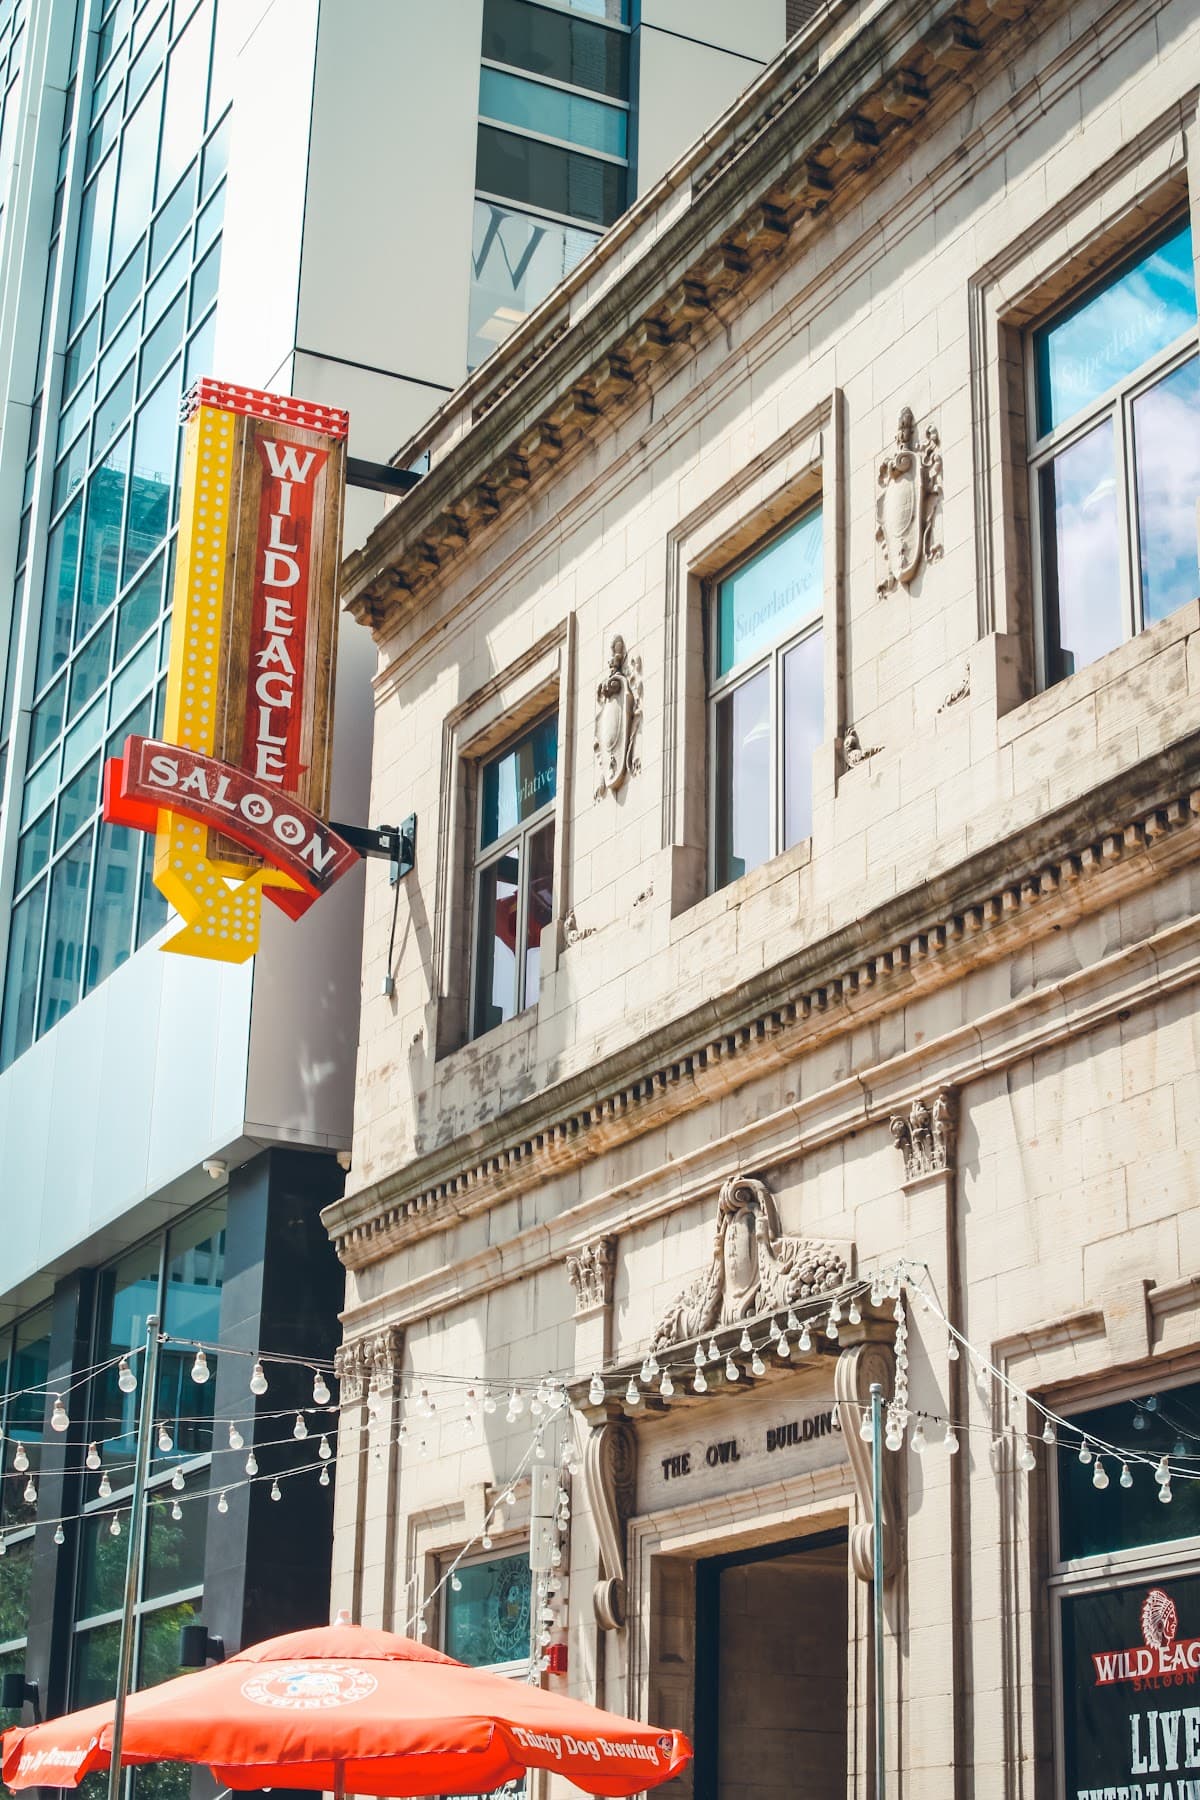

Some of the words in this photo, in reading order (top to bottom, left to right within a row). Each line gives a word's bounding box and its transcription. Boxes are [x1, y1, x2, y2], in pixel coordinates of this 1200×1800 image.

[262, 441, 316, 589] WILD
[735, 576, 813, 642] Superlative
[255, 597, 297, 784] EAGLE
[149, 755, 337, 873] SALOON
[661, 1453, 691, 1481] THE
[705, 1439, 741, 1468] OWL
[1095, 1650, 1153, 1682] WILD
[1133, 1671, 1196, 1693] SALOON
[562, 1734, 601, 1762] Dog
[595, 1737, 660, 1767] Brewing
[1129, 1706, 1200, 1775] LIVE
